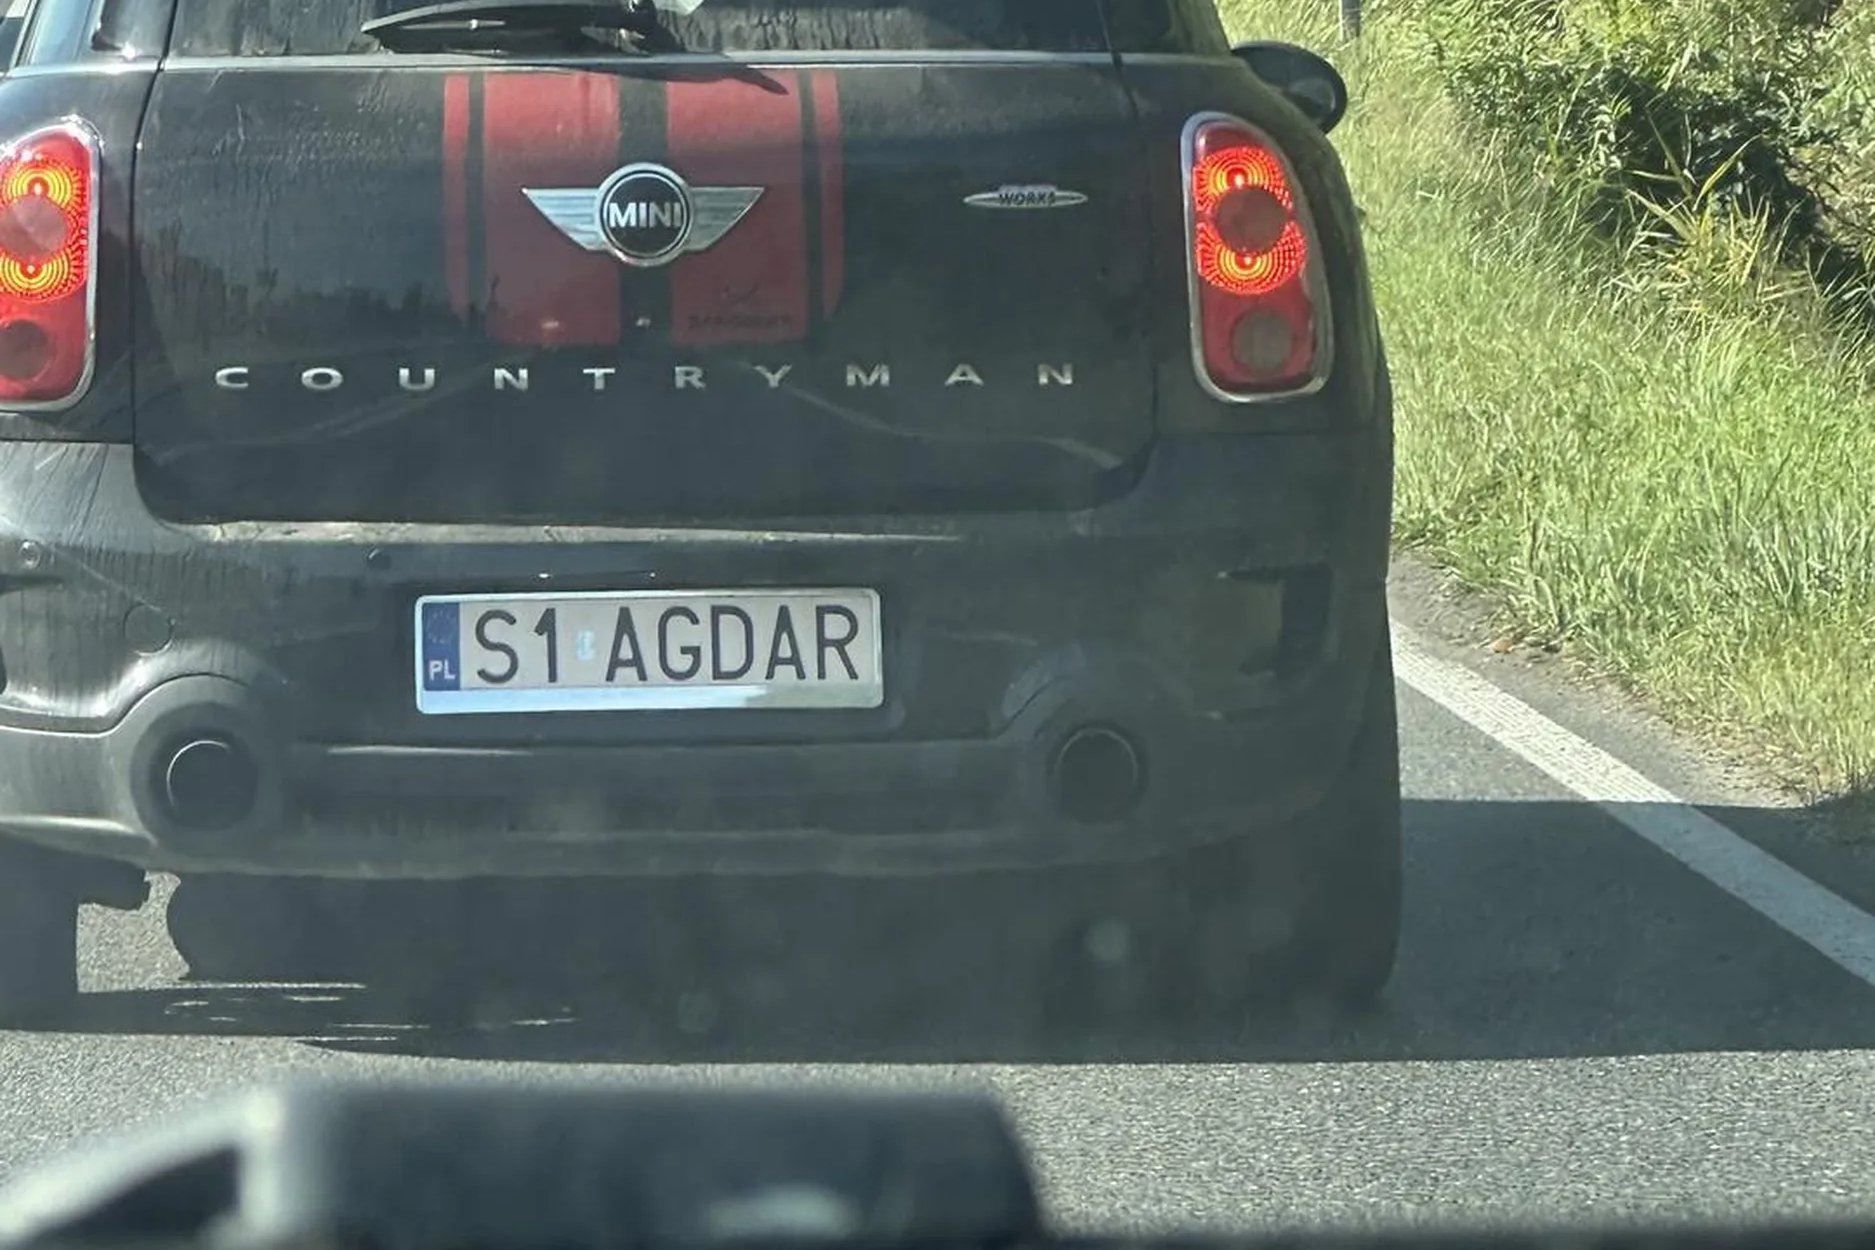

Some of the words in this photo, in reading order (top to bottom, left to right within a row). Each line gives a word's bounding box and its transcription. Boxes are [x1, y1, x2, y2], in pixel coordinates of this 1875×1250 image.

[608, 201, 682, 229] MINI
[214, 362, 1073, 391] COUNTRYMAN
[474, 607, 557, 684] S1
[605, 604, 861, 683] AGDAR
[429, 659, 456, 680] PL
